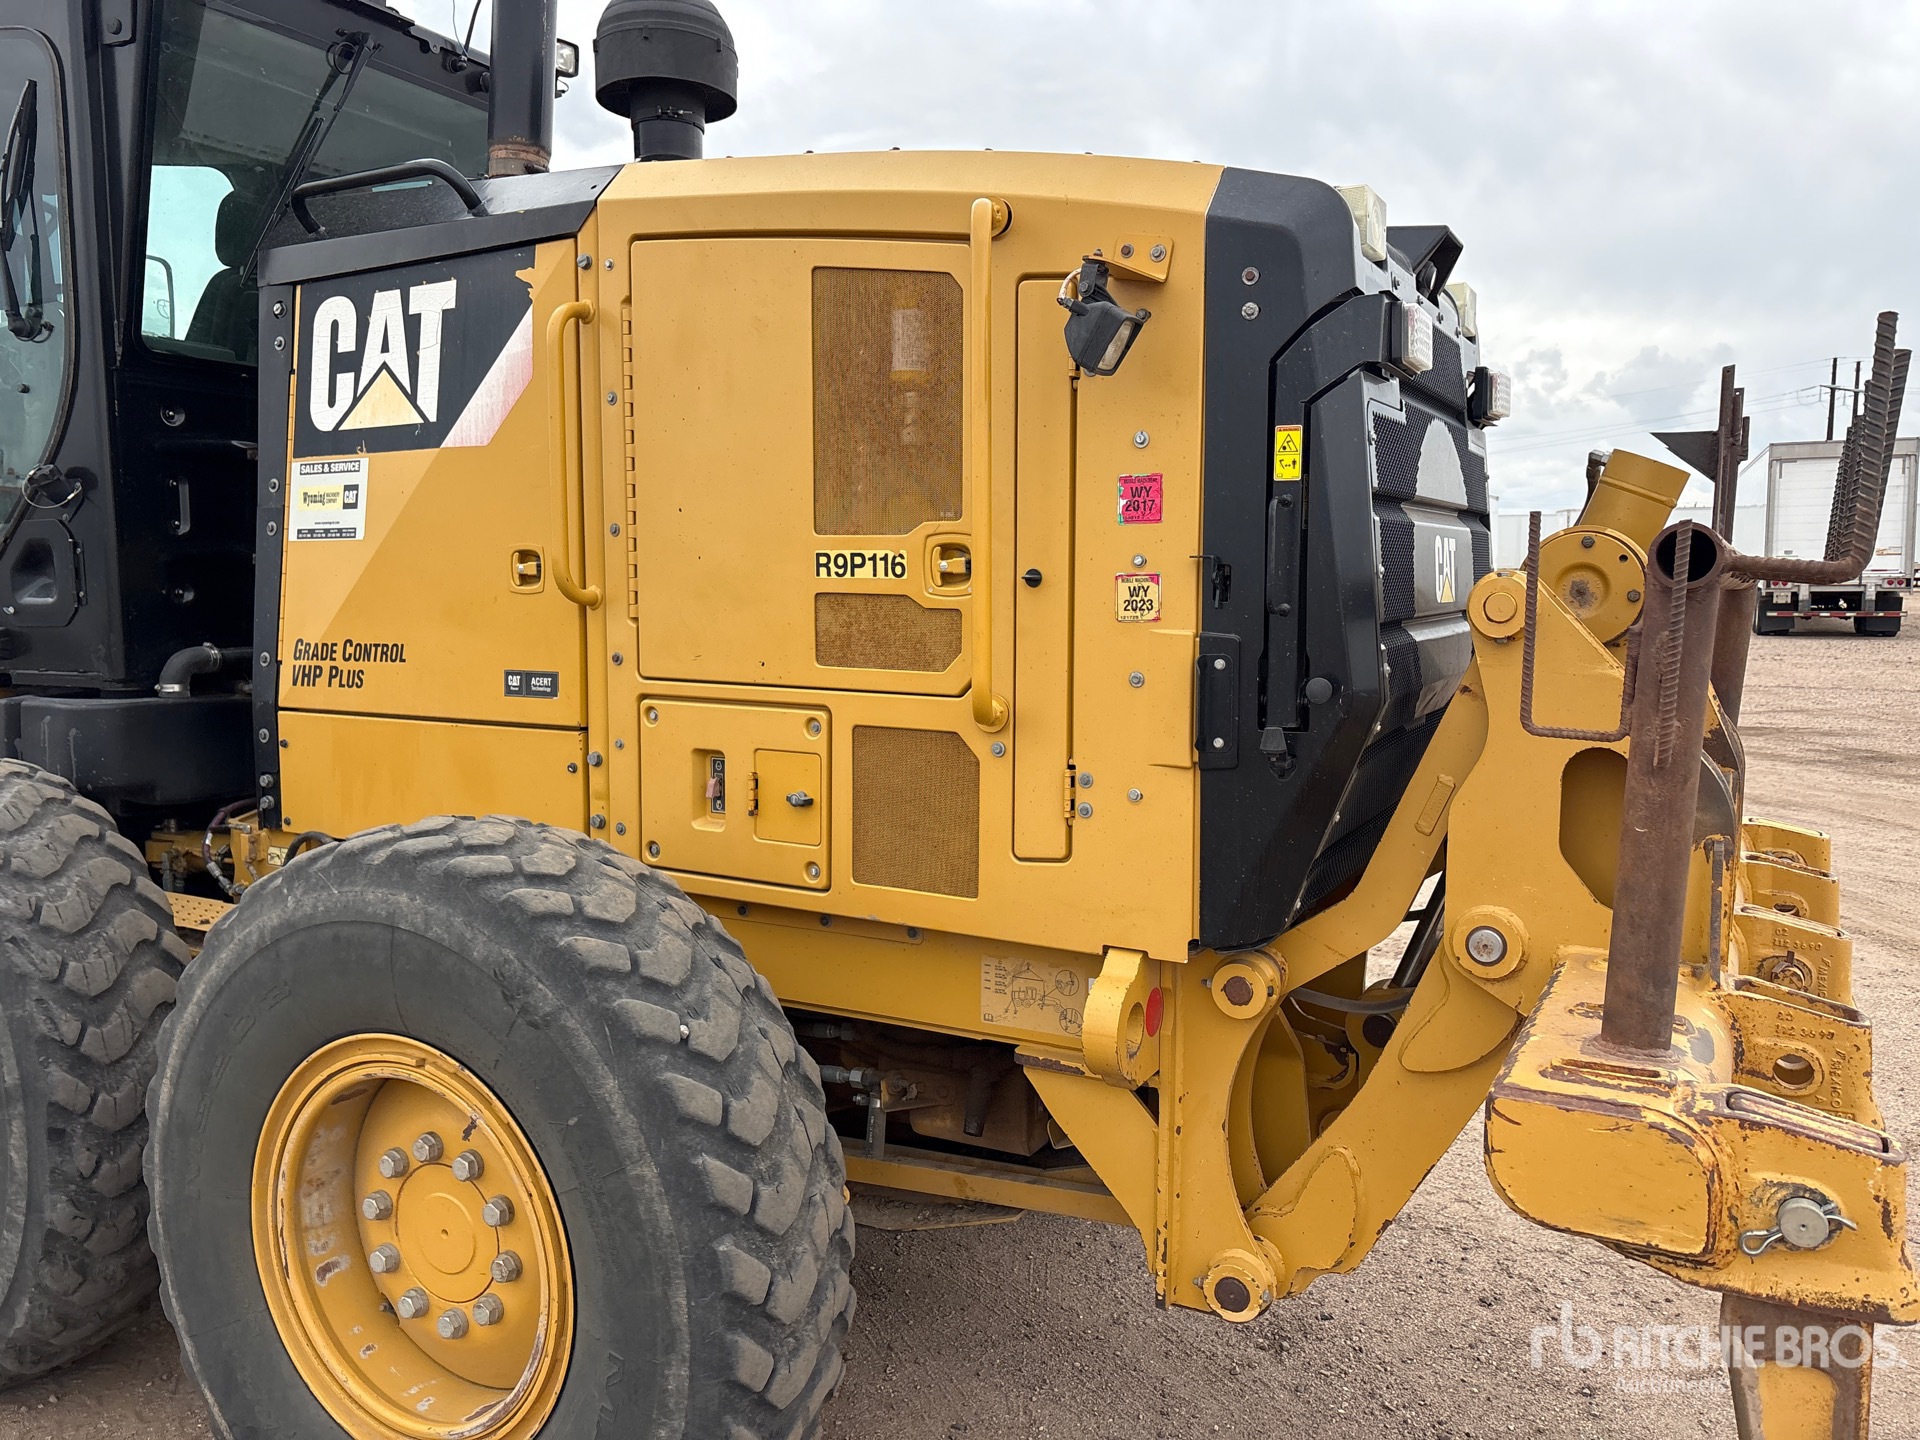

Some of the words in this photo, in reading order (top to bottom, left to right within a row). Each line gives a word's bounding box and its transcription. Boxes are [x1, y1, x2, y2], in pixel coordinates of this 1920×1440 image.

[310, 280, 457, 432] CAT
[301, 464, 322, 474] SALES
[323, 463, 330, 473] &
[330, 462, 360, 472] SERVICE
[344, 490, 358, 504] CAT
[1130, 486, 1152, 498] WY
[302, 491, 326, 507] Wyoming
[1125, 499, 1155, 512] 2017
[815, 552, 906, 578] R9P116
[1434, 534, 1456, 604] CAT
[1127, 585, 1150, 598] WY
[1123, 599, 1154, 612] 2023
[292, 664, 323, 687] VHP
[508, 675, 521, 686] CAT
[531, 677, 552, 686] ACERT
